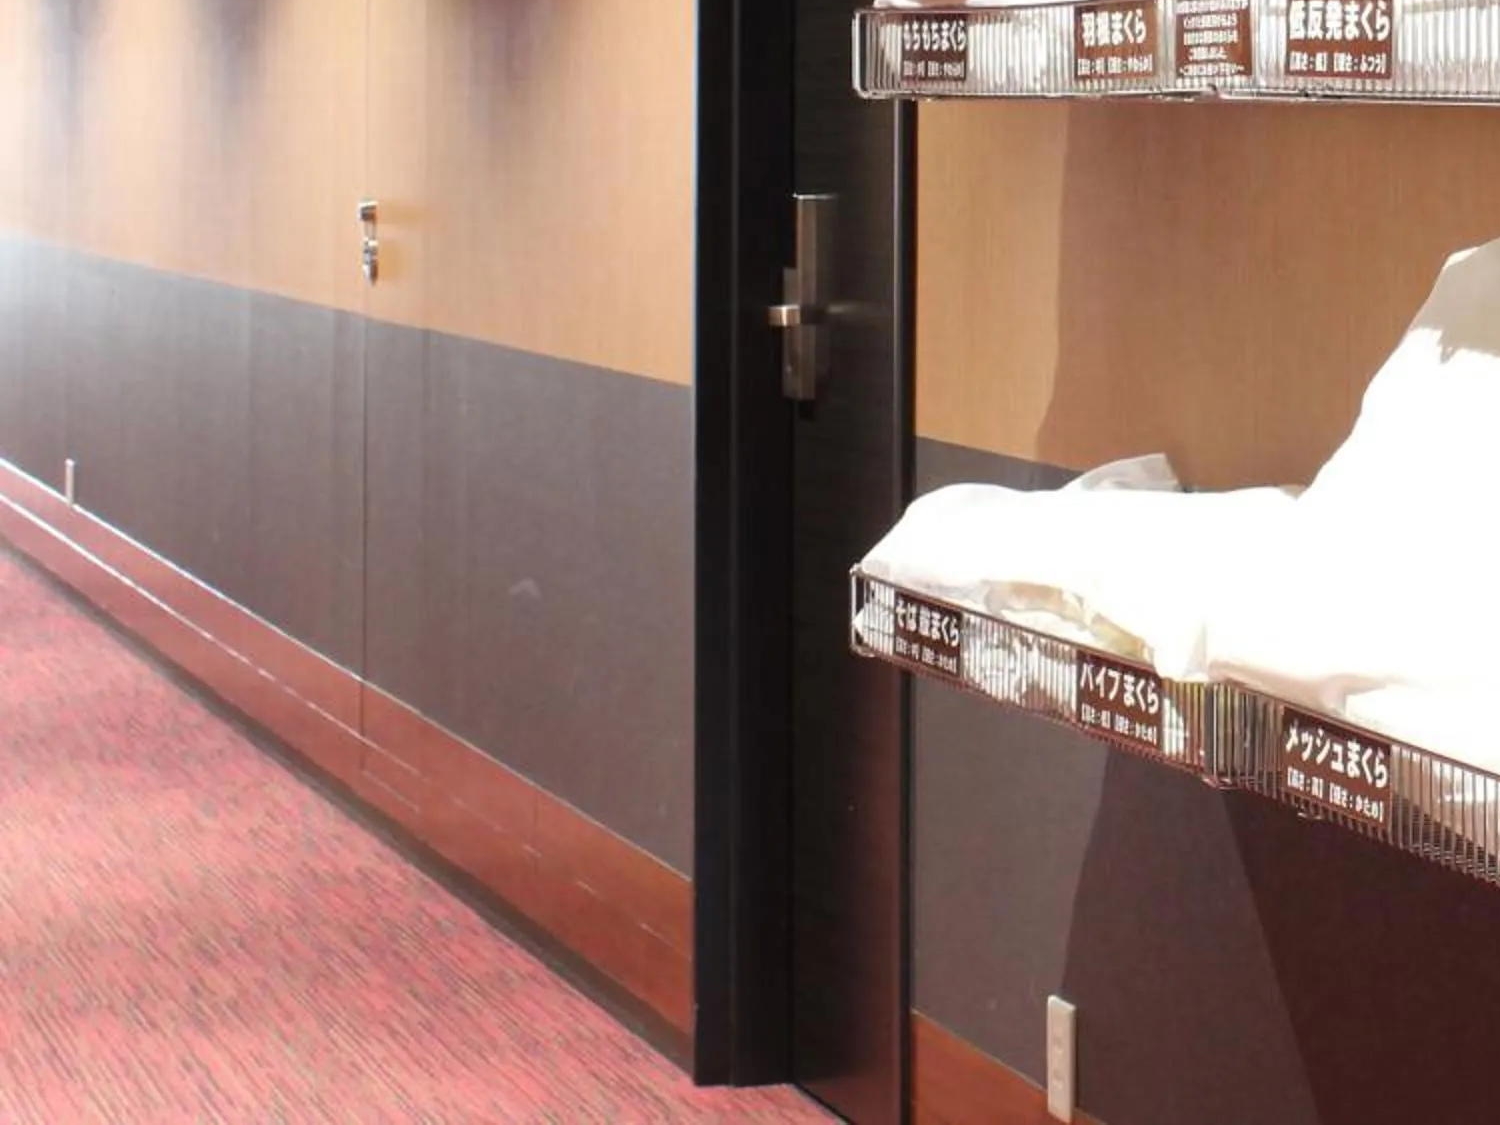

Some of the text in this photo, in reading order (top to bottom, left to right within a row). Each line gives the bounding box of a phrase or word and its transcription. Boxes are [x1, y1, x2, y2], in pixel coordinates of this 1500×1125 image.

[1289, 0, 1390, 41] 低反発まくら
[1286, 719, 1388, 788] メッシュまくら
